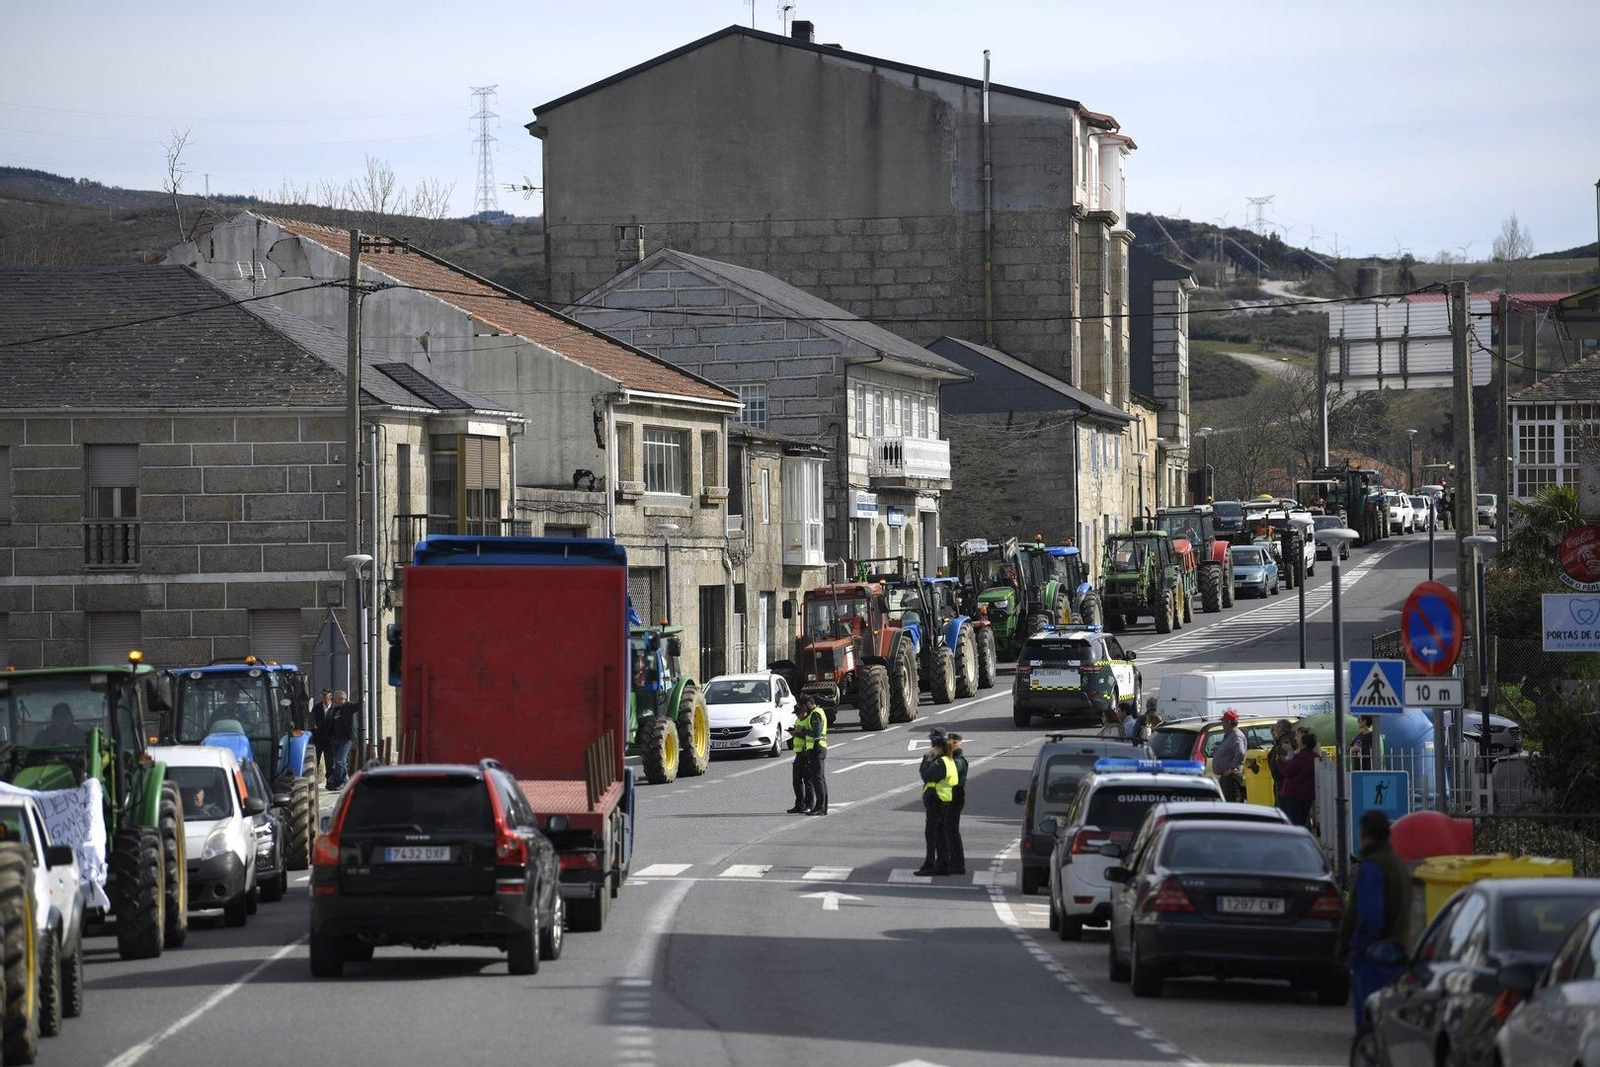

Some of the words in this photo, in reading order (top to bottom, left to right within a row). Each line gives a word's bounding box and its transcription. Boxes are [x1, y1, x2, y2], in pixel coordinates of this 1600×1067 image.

[1560, 573, 1575, 586] BAR
[1575, 580, 1581, 589] O
[1546, 630, 1579, 640] PORTAS
[1581, 630, 1592, 640] DE
[1416, 684, 1430, 701] 10
[1439, 689, 1450, 701] m
[1118, 794, 1167, 803] GUARDIA
[393, 848, 421, 859] 7432
[425, 848, 447, 859] DXF
[1227, 899, 1255, 911] 1297
[1259, 899, 1281, 911] CWF
